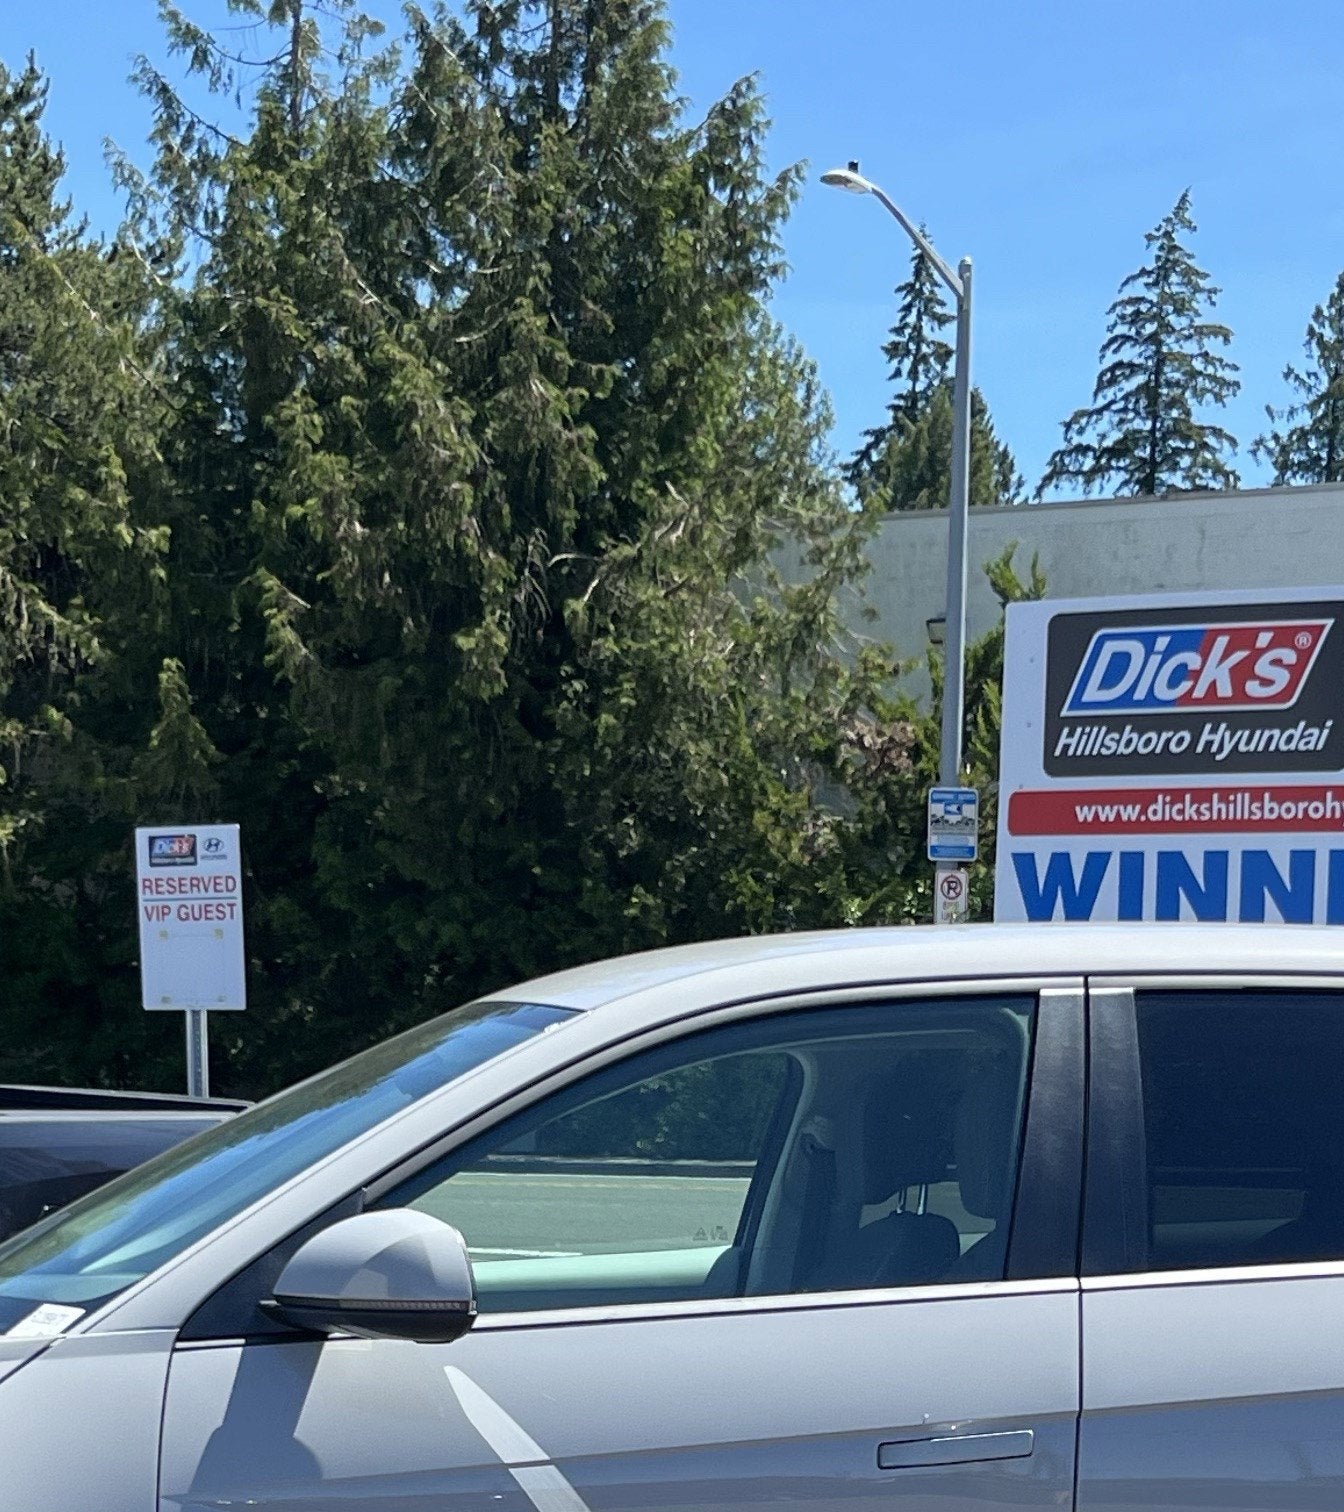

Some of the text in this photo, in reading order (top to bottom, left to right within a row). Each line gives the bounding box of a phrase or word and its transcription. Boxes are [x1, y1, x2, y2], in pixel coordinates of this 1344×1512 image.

[1053, 719, 1334, 762] Hillsboro Hyundai
[141, 875, 237, 896] RESERVED
[143, 902, 237, 923] VIP GUEST
